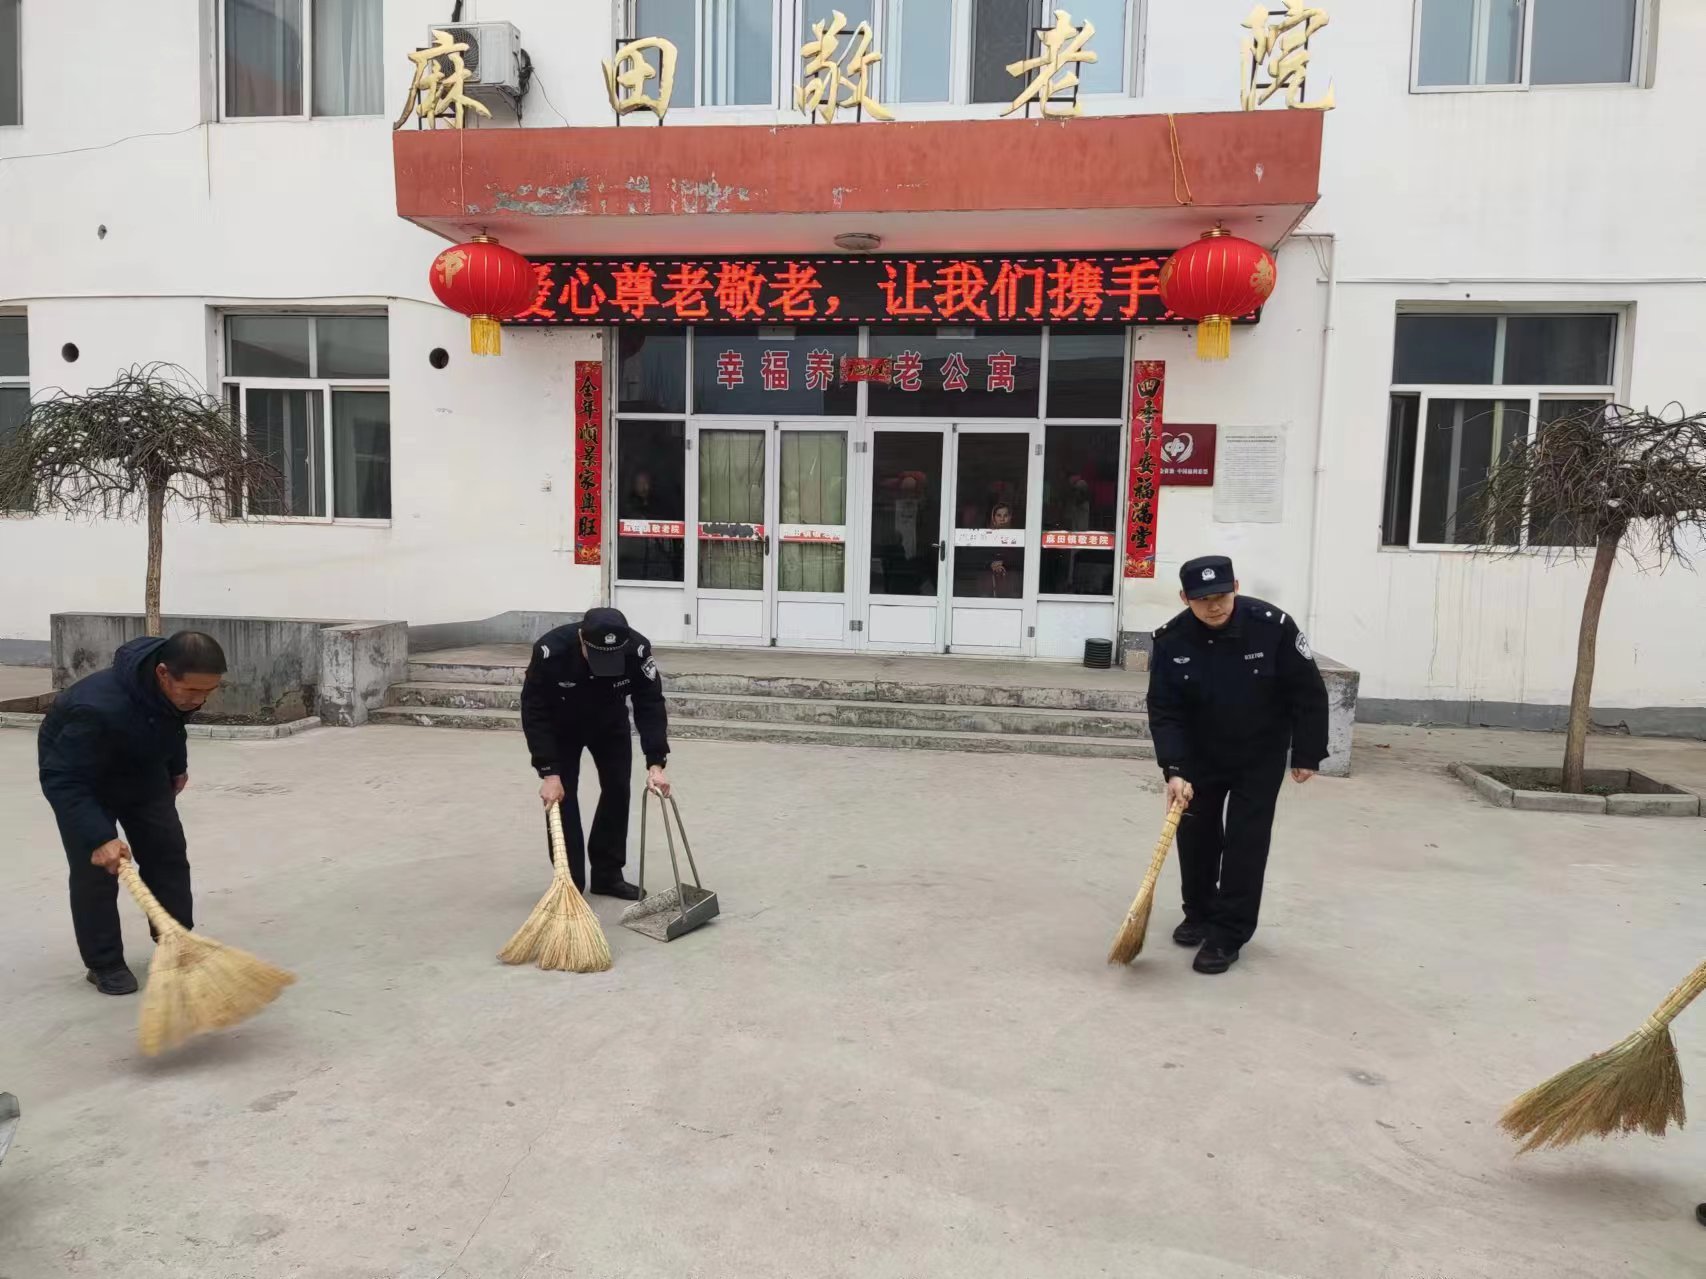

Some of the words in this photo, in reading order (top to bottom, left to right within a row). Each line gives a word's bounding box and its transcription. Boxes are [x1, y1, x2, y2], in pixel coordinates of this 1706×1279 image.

[393, 1, 1335, 130] 麻田敬老院
[716, 349, 1017, 392] 幸福养老公寓
